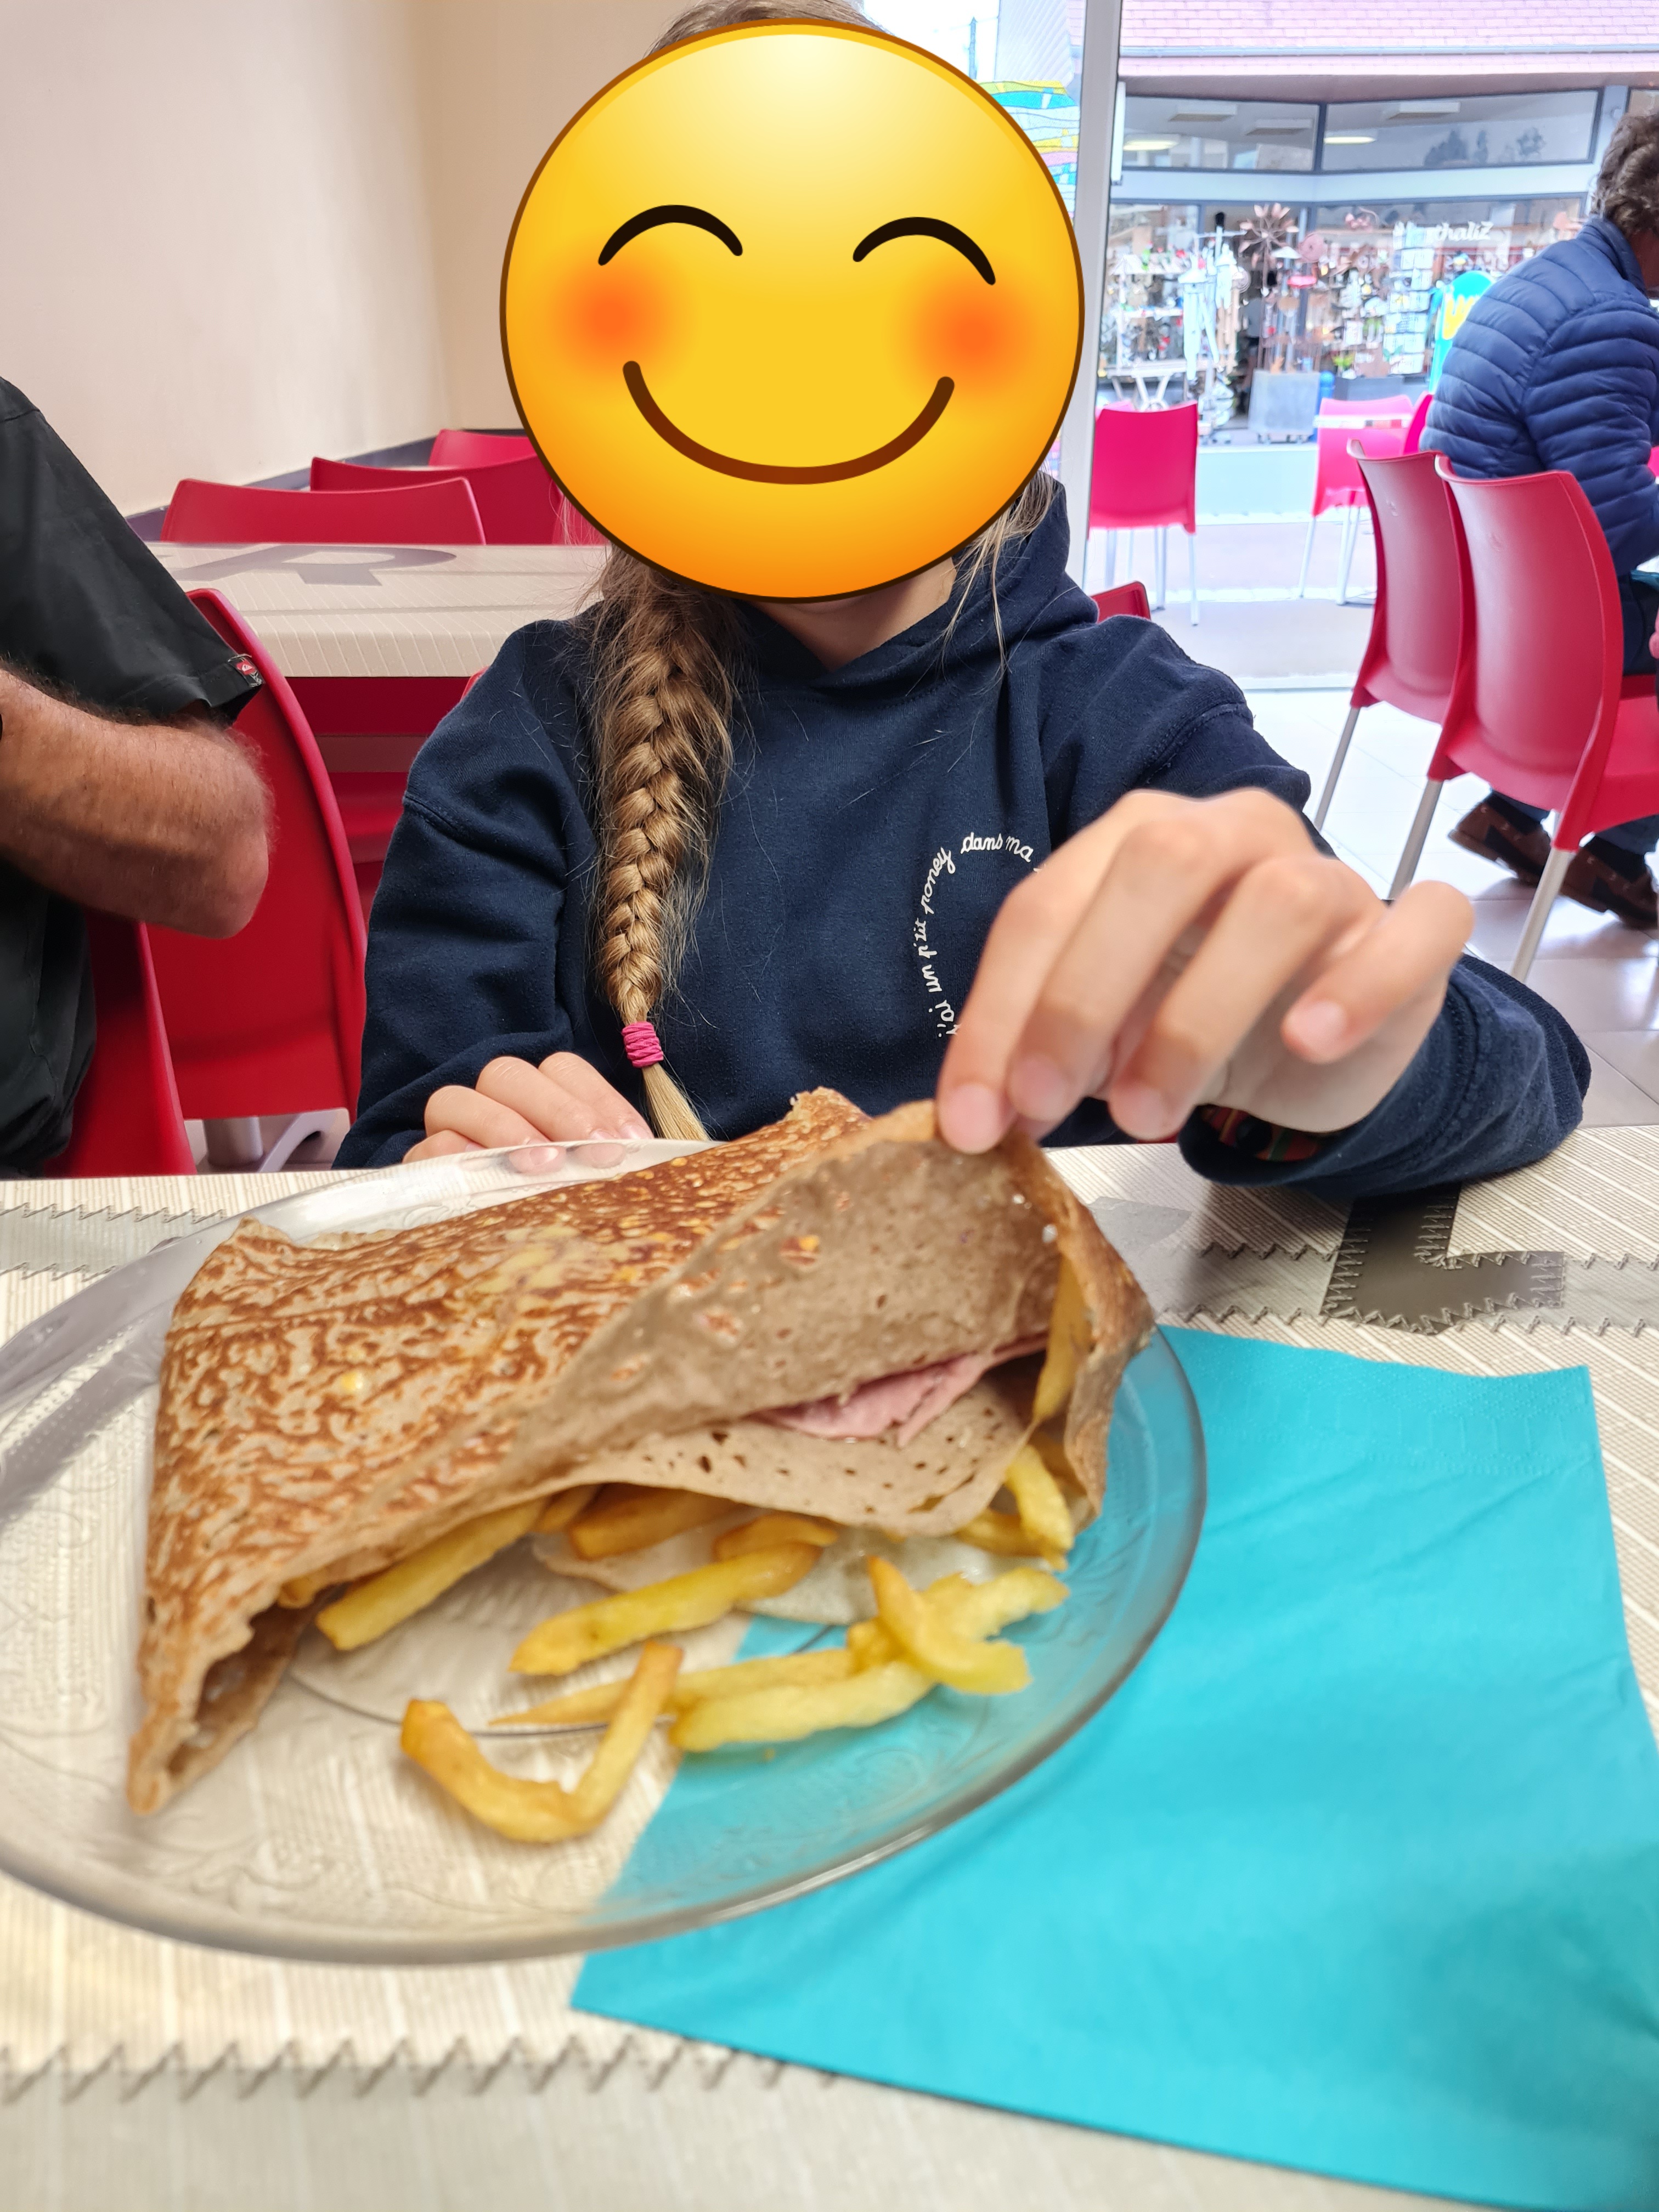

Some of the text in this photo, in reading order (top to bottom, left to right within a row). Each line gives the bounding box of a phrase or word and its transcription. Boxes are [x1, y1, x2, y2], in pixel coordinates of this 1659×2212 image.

[960, 832, 1003, 854] dans
[1005, 836, 1034, 862] ma
[921, 847, 956, 915] poney
[913, 917, 938, 959] p'tit
[921, 964, 943, 992] un
